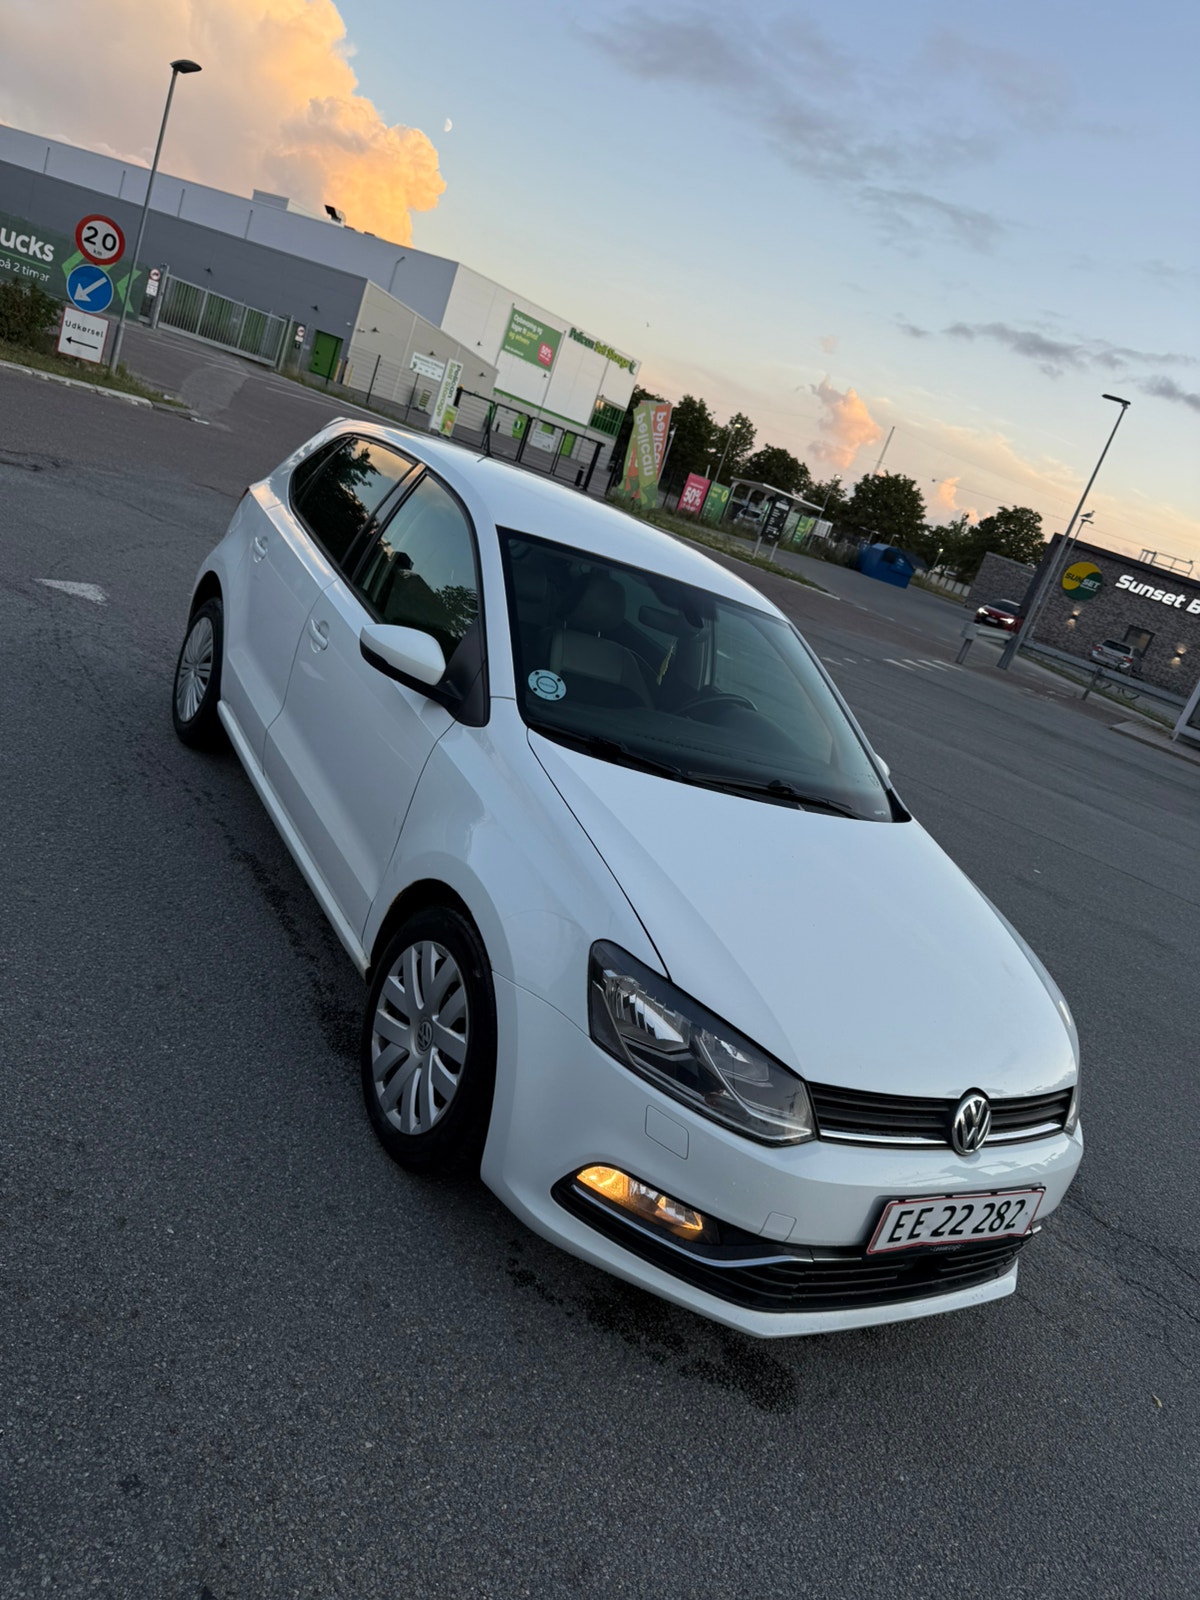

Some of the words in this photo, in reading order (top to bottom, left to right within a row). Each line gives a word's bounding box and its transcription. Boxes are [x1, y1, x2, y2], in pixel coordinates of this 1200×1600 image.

[1, 227, 55, 262] ucks
[83, 226, 117, 252] 20
[92, 248, 103, 256] km
[13, 262, 20, 273] 2
[22, 265, 50, 282] timer
[65, 320, 104, 338] Udkørsel
[448, 364, 462, 398] Pelican
[683, 486, 703, 506] 50%
[1115, 574, 1187, 609] Sunset
[887, 1207, 934, 1243] EE
[930, 1204, 974, 1237] 22
[971, 1199, 1026, 1234] 282
